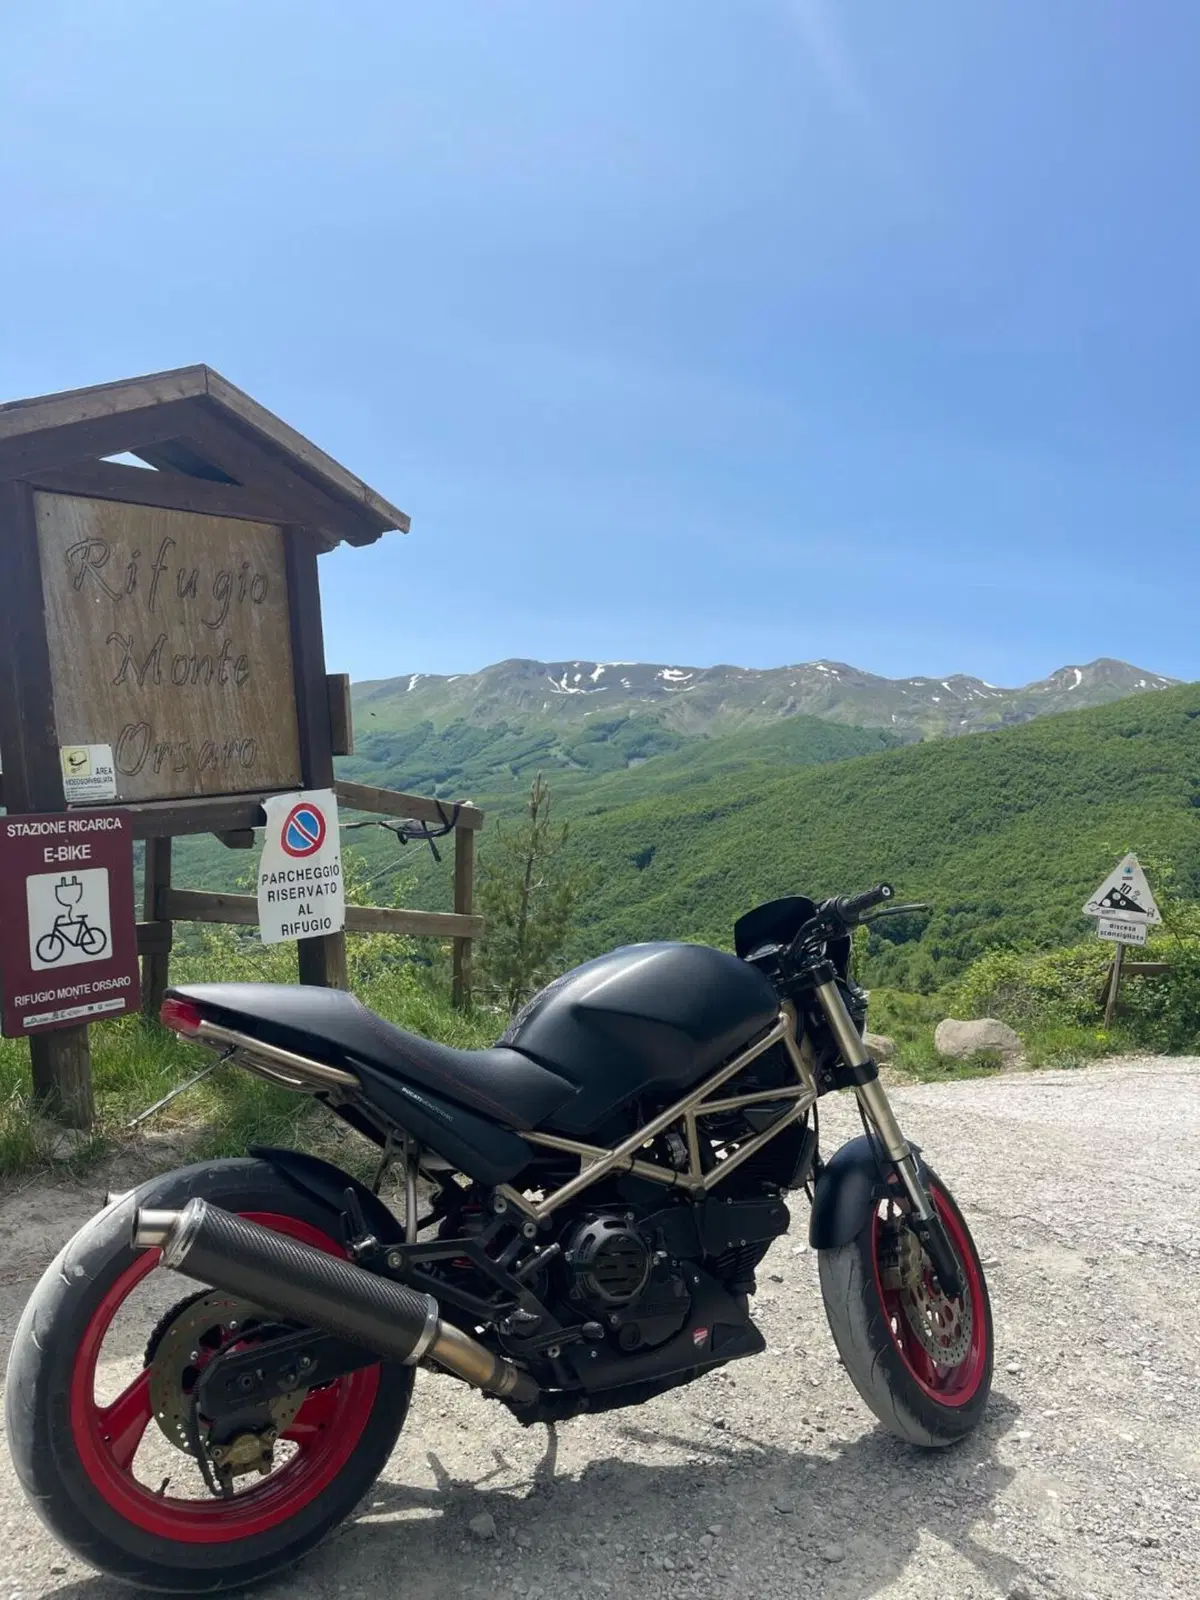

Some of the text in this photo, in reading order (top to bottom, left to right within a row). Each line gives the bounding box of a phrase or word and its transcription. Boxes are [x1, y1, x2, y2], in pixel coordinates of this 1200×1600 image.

[66, 536, 268, 630] Rifugio
[106, 632, 250, 686] Monte
[114, 721, 257, 776] Orsaro
[96, 767, 113, 775] AREA
[7, 817, 122, 837] STAZIONE RICARICA
[44, 844, 92, 863] E-BIKE
[262, 864, 340, 885] PARCHEGGIO
[268, 882, 337, 902] RISERVATO
[298, 904, 314, 916] AL
[281, 917, 332, 936] RIFUGIO
[14, 976, 131, 1007] RIFUGIO MONTE ORSARO
